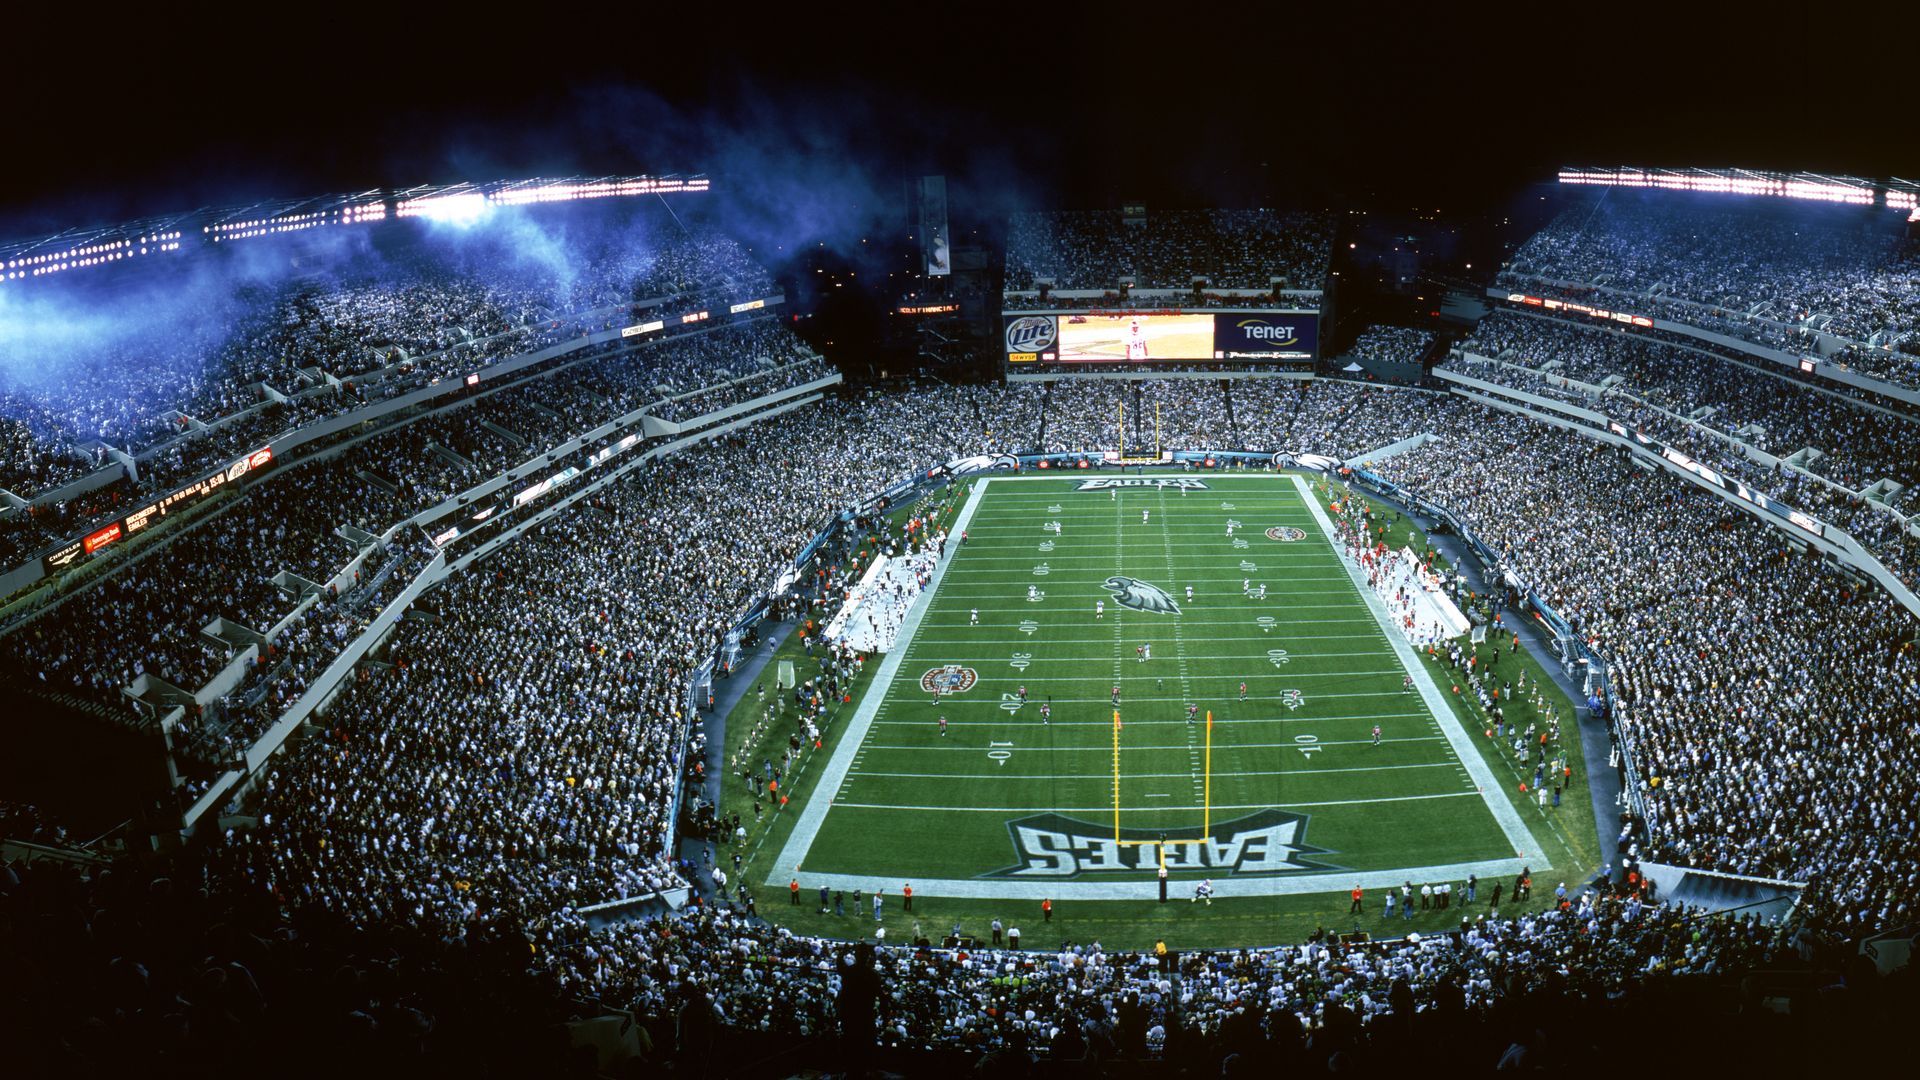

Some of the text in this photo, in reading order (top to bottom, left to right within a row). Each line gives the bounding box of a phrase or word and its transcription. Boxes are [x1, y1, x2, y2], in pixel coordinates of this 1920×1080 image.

[1012, 324, 1053, 346] Lite
[1077, 478, 1210, 490] EAGLES
[128, 517, 148, 533] EAGLES
[48, 542, 81, 562] CHRYSLER
[1010, 652, 1032, 667] 30
[1267, 649, 1290, 664] 30
[1000, 693, 1024, 710] 20
[987, 740, 1014, 759] 10
[1294, 734, 1323, 752] 10
[1011, 819, 1305, 876] EAGLES
